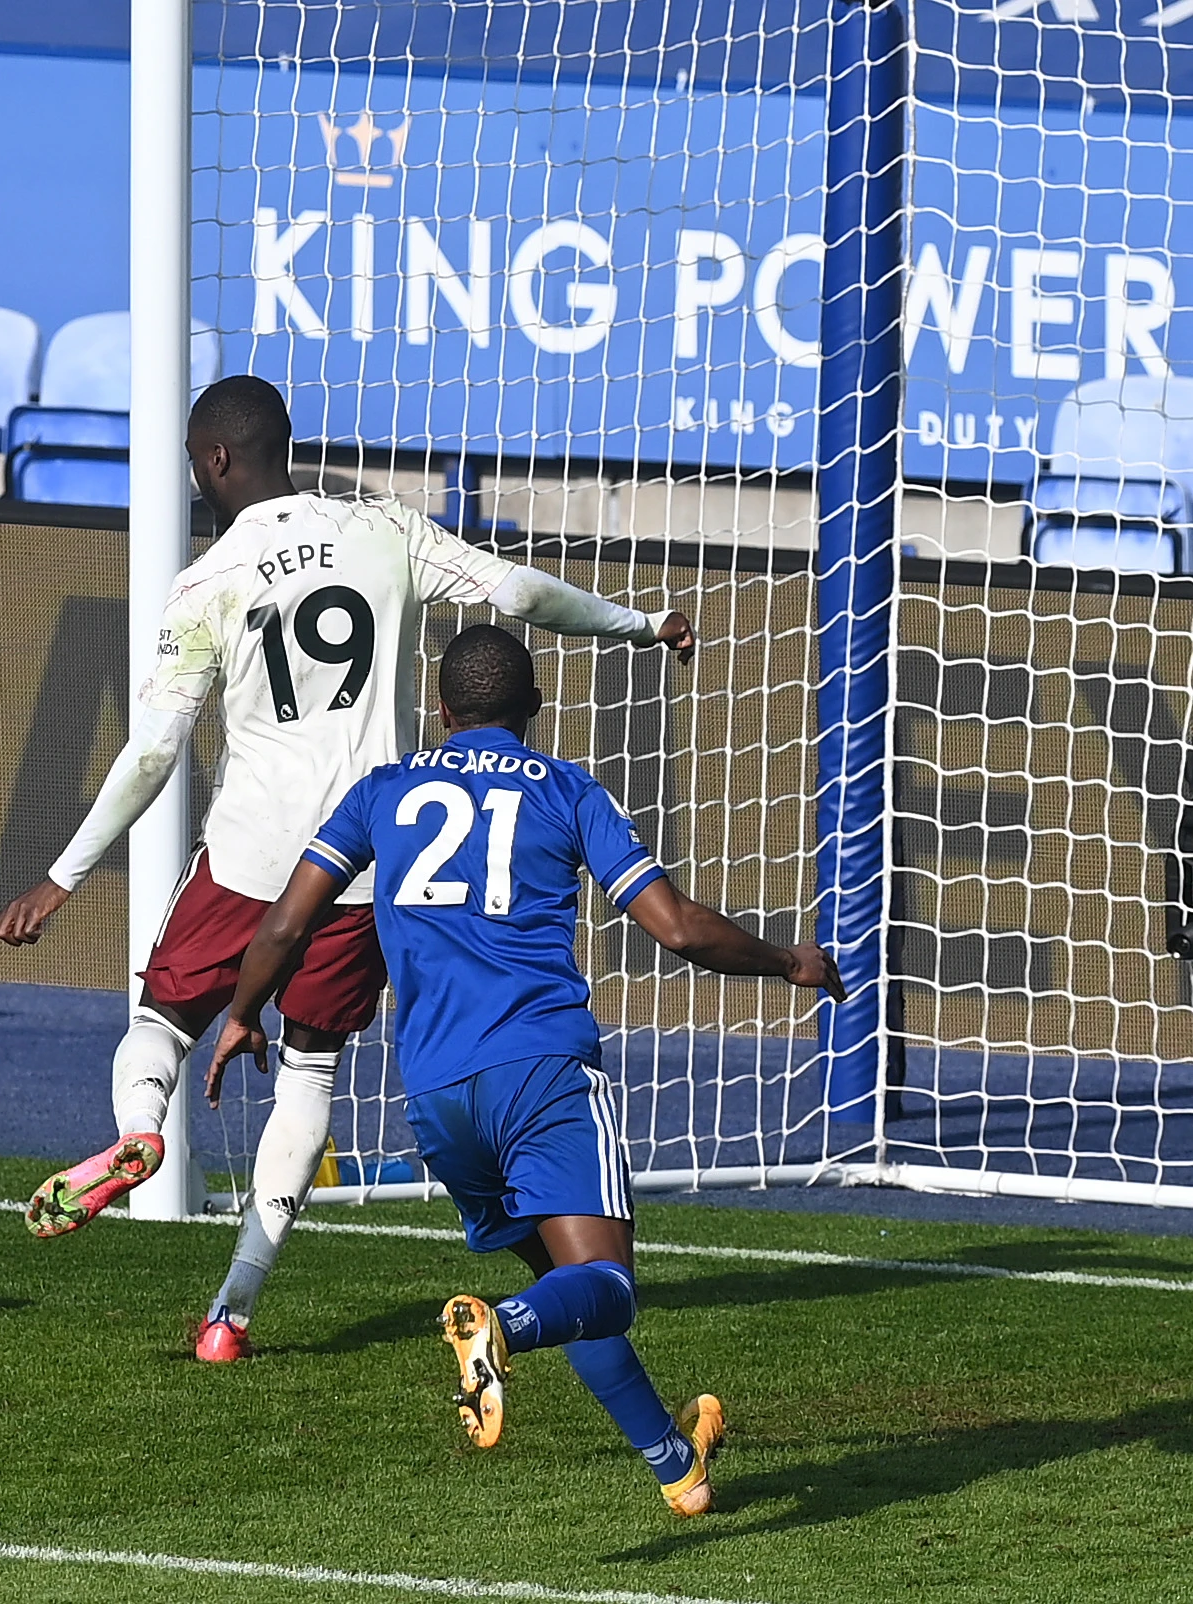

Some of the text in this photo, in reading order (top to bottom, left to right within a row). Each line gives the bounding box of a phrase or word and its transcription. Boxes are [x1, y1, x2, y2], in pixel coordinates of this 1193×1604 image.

[255, 207, 618, 355] KING
[675, 396, 1036, 449] KING DUTY
[257, 543, 334, 585] PEPE
[247, 585, 375, 723] 19
[409, 749, 547, 781] RICARDO
[393, 780, 523, 916] 21
